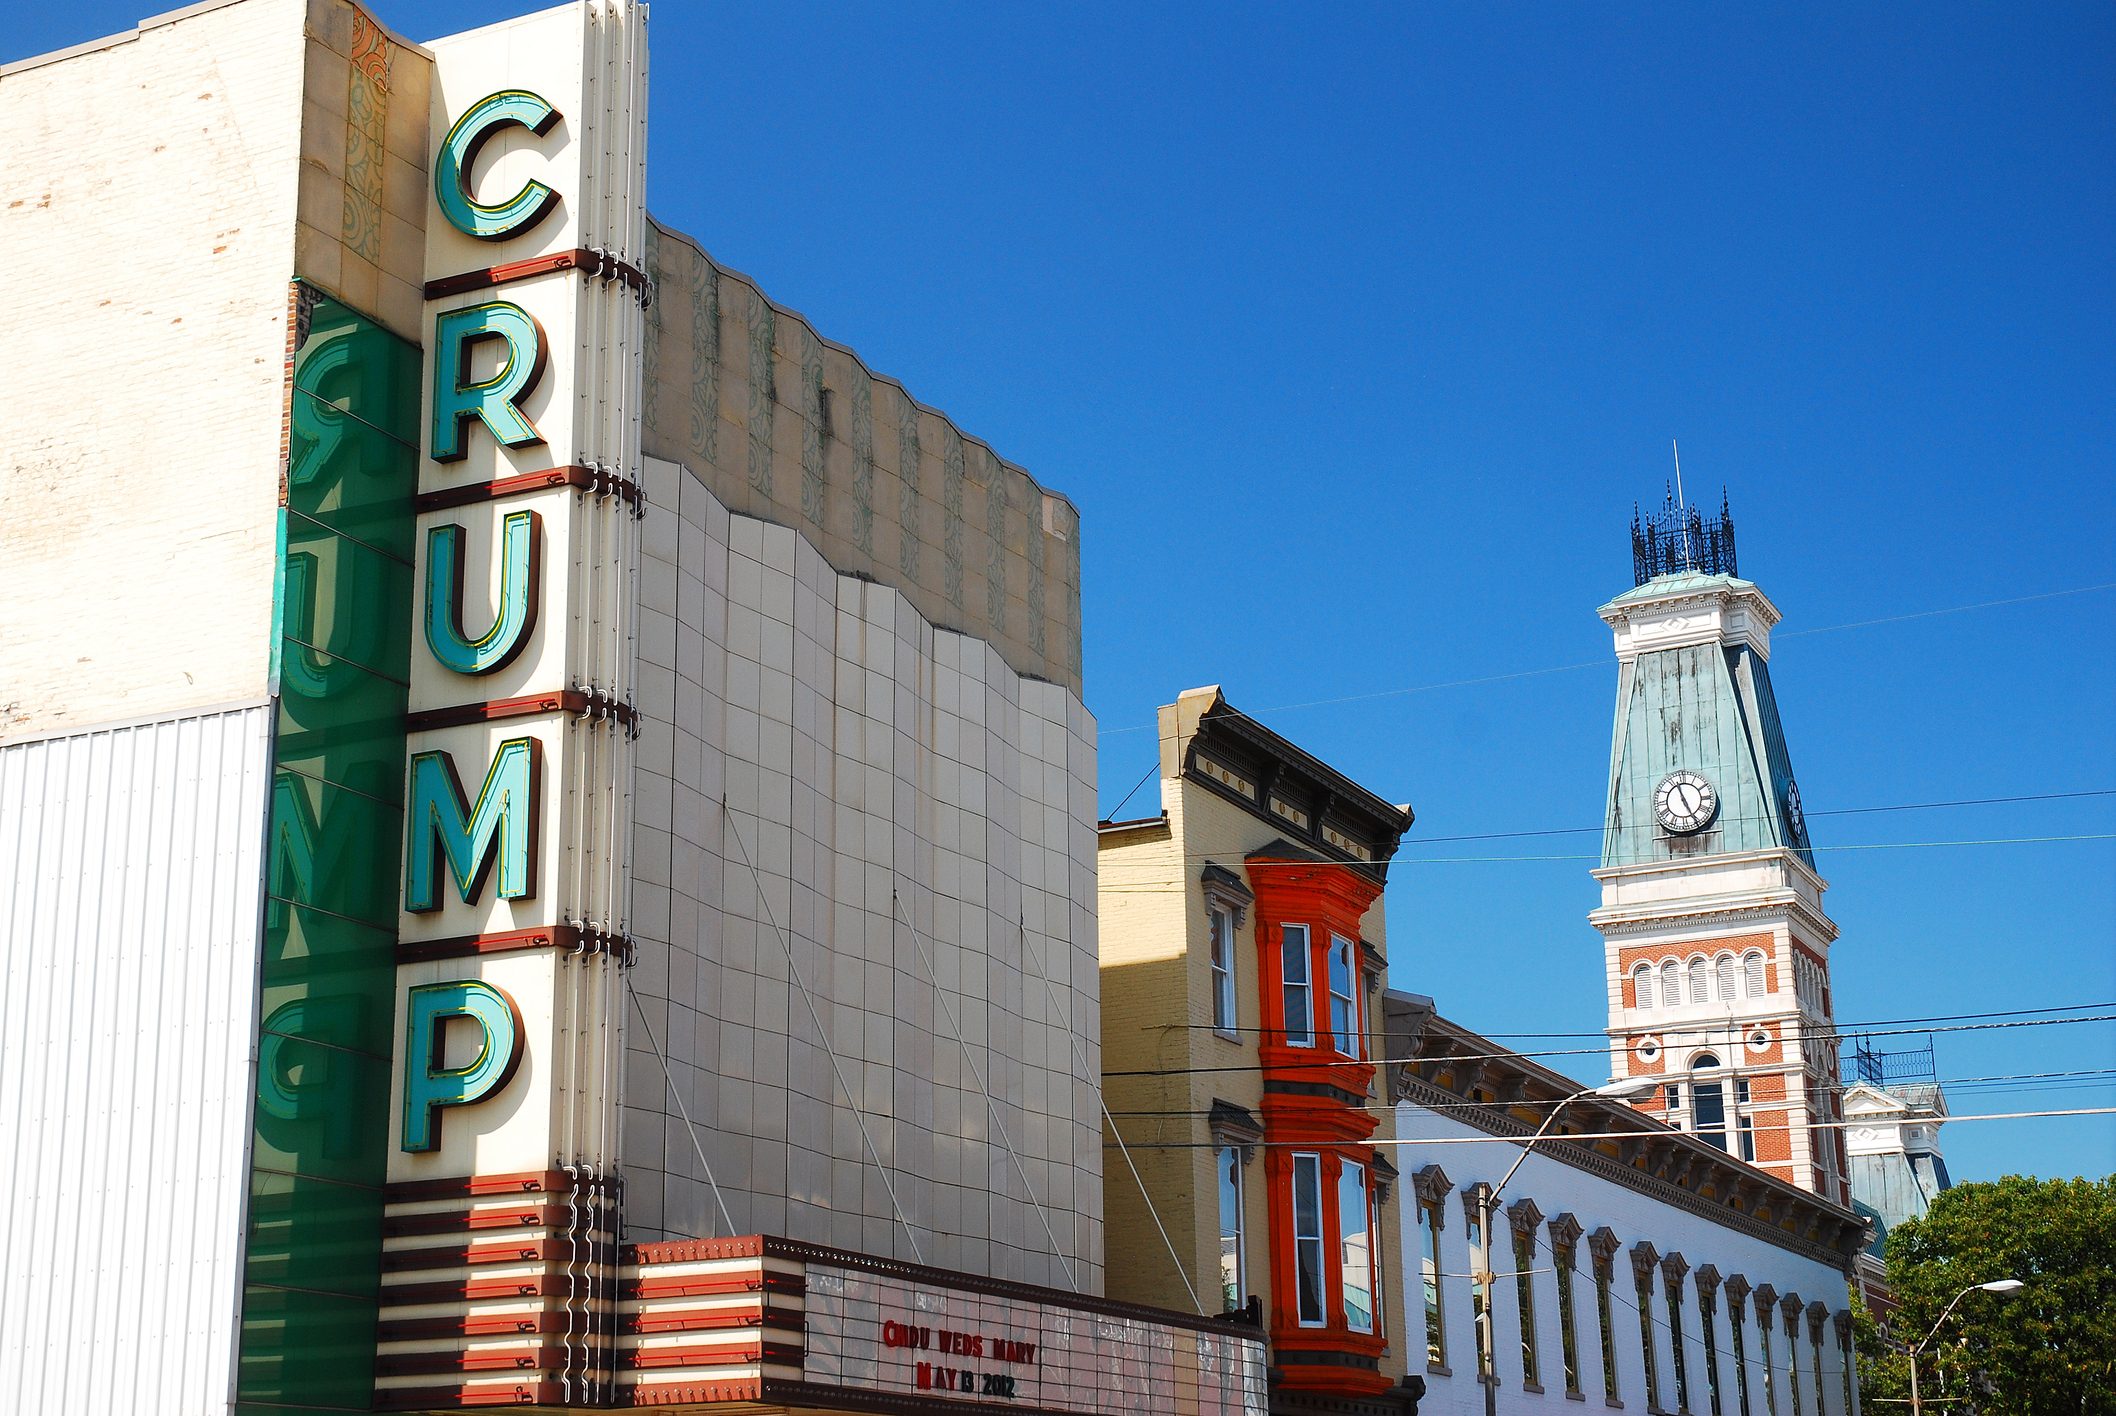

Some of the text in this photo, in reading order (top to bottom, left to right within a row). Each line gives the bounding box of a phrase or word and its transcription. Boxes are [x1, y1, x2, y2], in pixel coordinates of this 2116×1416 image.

[401, 89, 564, 1153] CRUMP
[939, 1330, 983, 1357] WEDS
[993, 1338, 1036, 1364] MARY
[917, 1362, 1015, 1398] MAY 13 2012
